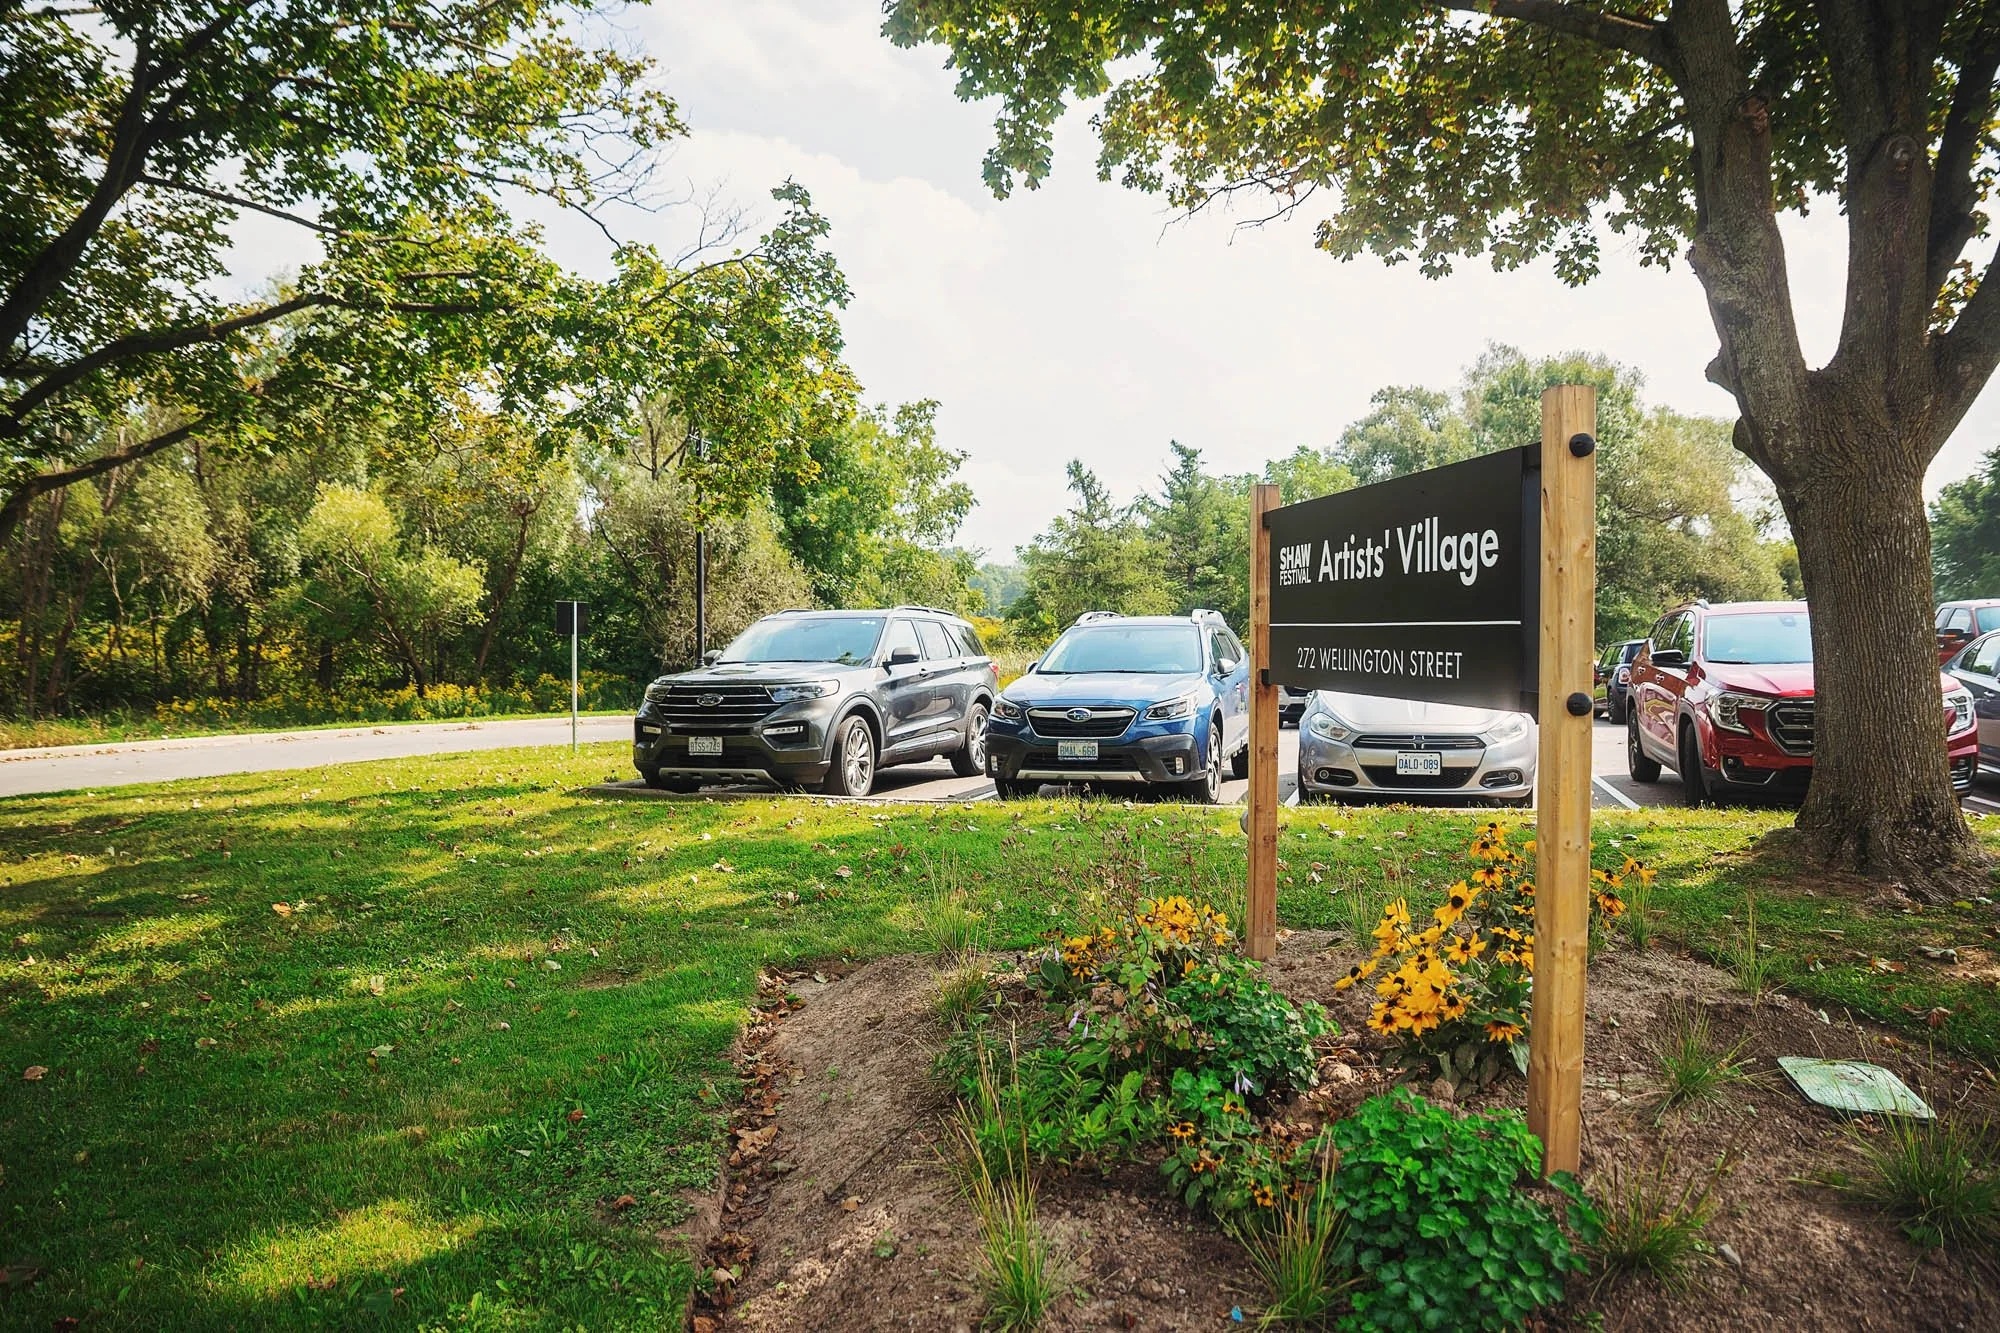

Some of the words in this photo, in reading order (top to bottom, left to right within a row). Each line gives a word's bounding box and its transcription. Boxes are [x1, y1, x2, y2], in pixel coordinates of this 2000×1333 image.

[1280, 543, 1311, 570] SHAW
[1318, 529, 1389, 582] Artists'
[1396, 516, 1499, 586] Village
[1280, 568, 1311, 586] FESTIVAL
[1297, 647, 1316, 669] 272
[1319, 648, 1404, 676] WELLINGTON
[1409, 650, 1463, 680] STREET
